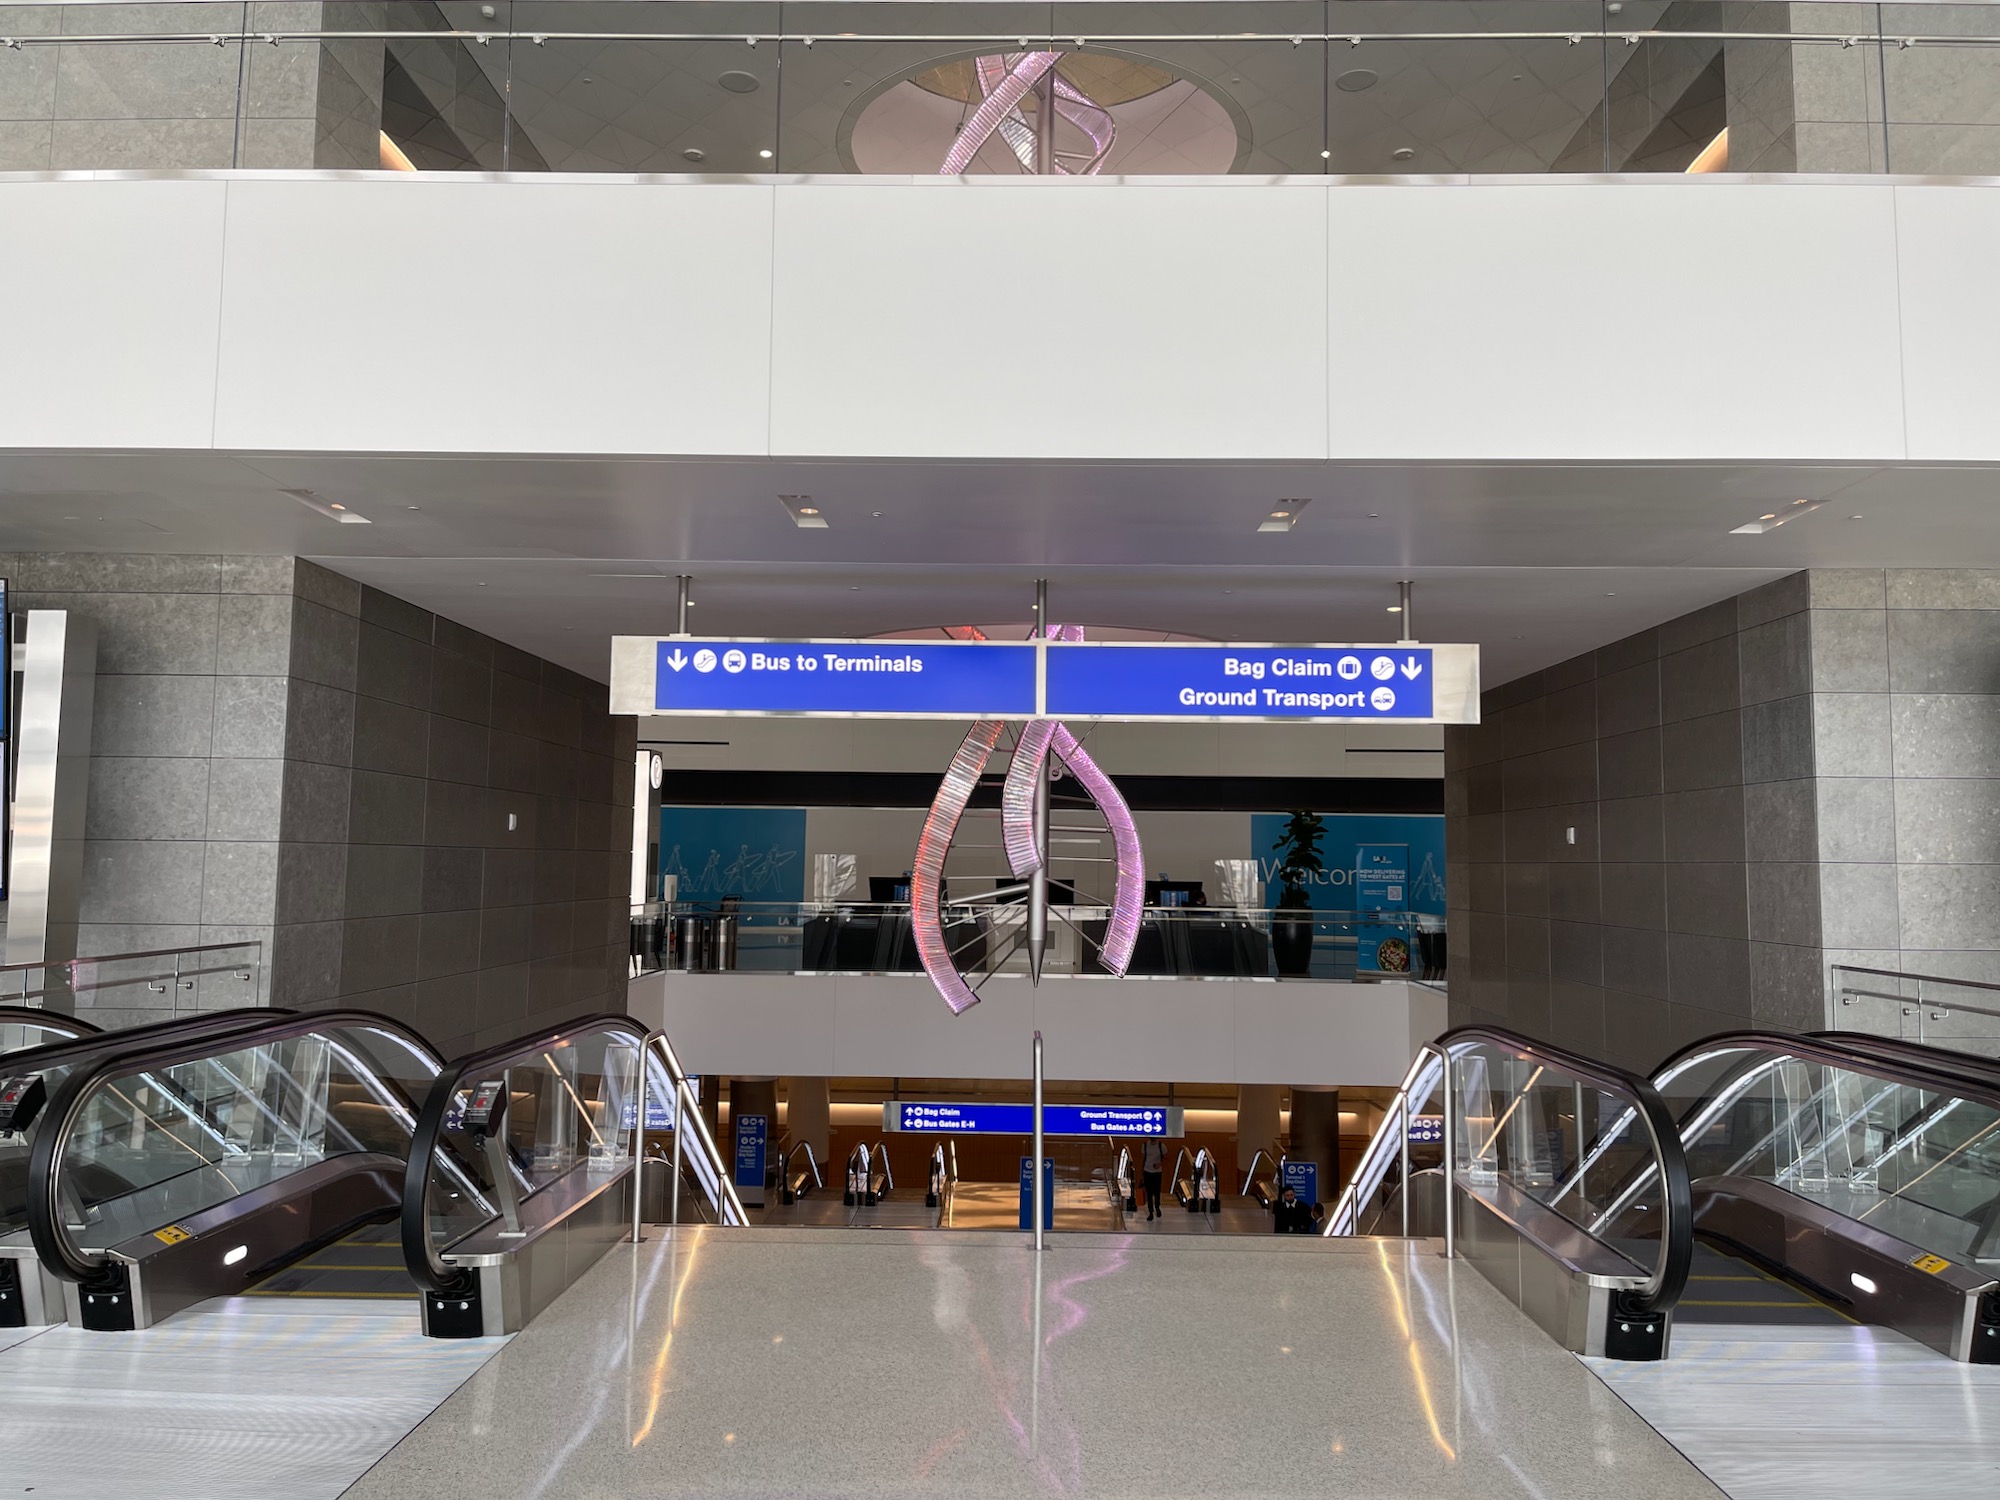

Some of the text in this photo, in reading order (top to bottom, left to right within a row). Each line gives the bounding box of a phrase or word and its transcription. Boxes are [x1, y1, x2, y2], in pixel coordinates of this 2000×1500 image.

[751, 653, 923, 673] Bus to Terminals
[1224, 658, 1332, 680] Bag Claim
[1179, 687, 1365, 711] Ground Transport
[923, 1108, 960, 1117] Bag Claim
[1080, 1111, 1143, 1120] Ground Transport
[923, 1120, 975, 1128] Bus Gates E-H
[1090, 1123, 1143, 1131] Bus Gates A-D
